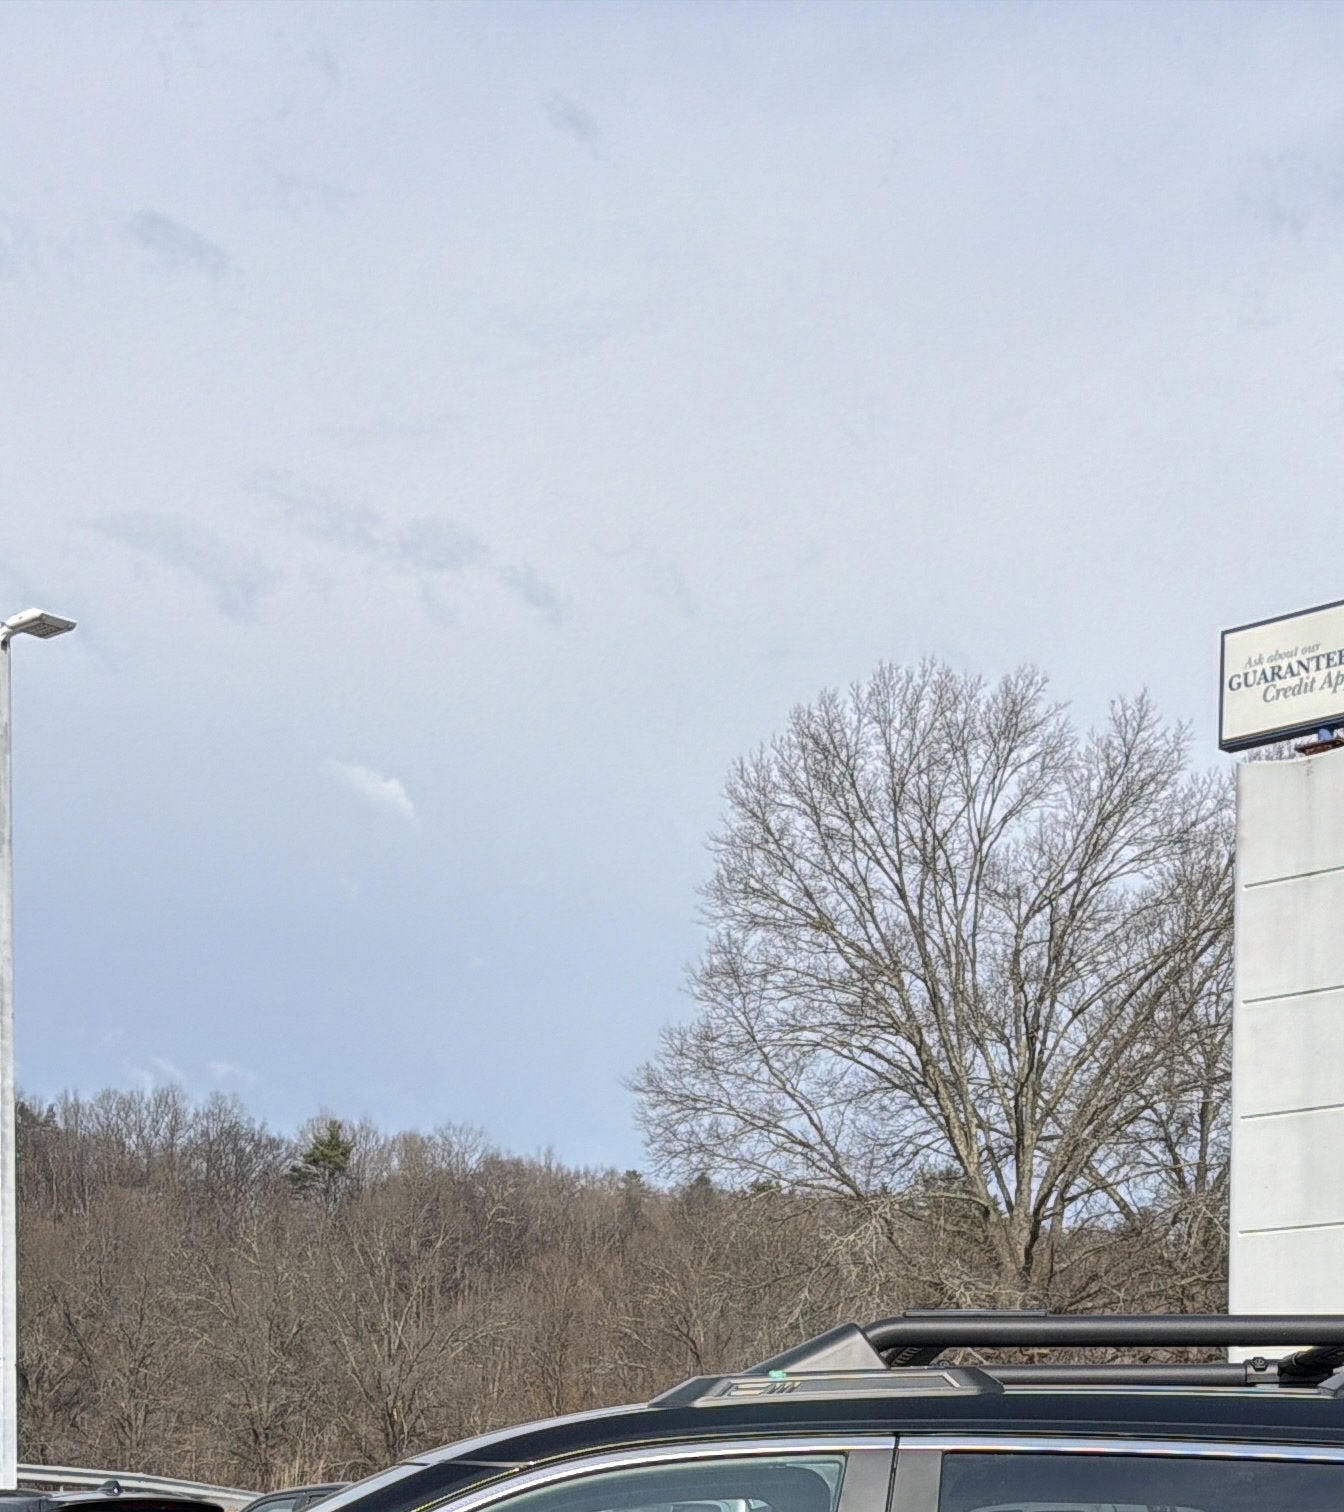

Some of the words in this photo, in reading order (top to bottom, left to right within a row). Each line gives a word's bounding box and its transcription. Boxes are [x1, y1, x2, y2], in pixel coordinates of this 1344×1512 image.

[1245, 654, 1264, 669] Ask
[1267, 647, 1299, 663] about
[1301, 643, 1322, 655] our
[1262, 675, 1316, 703] Credit
